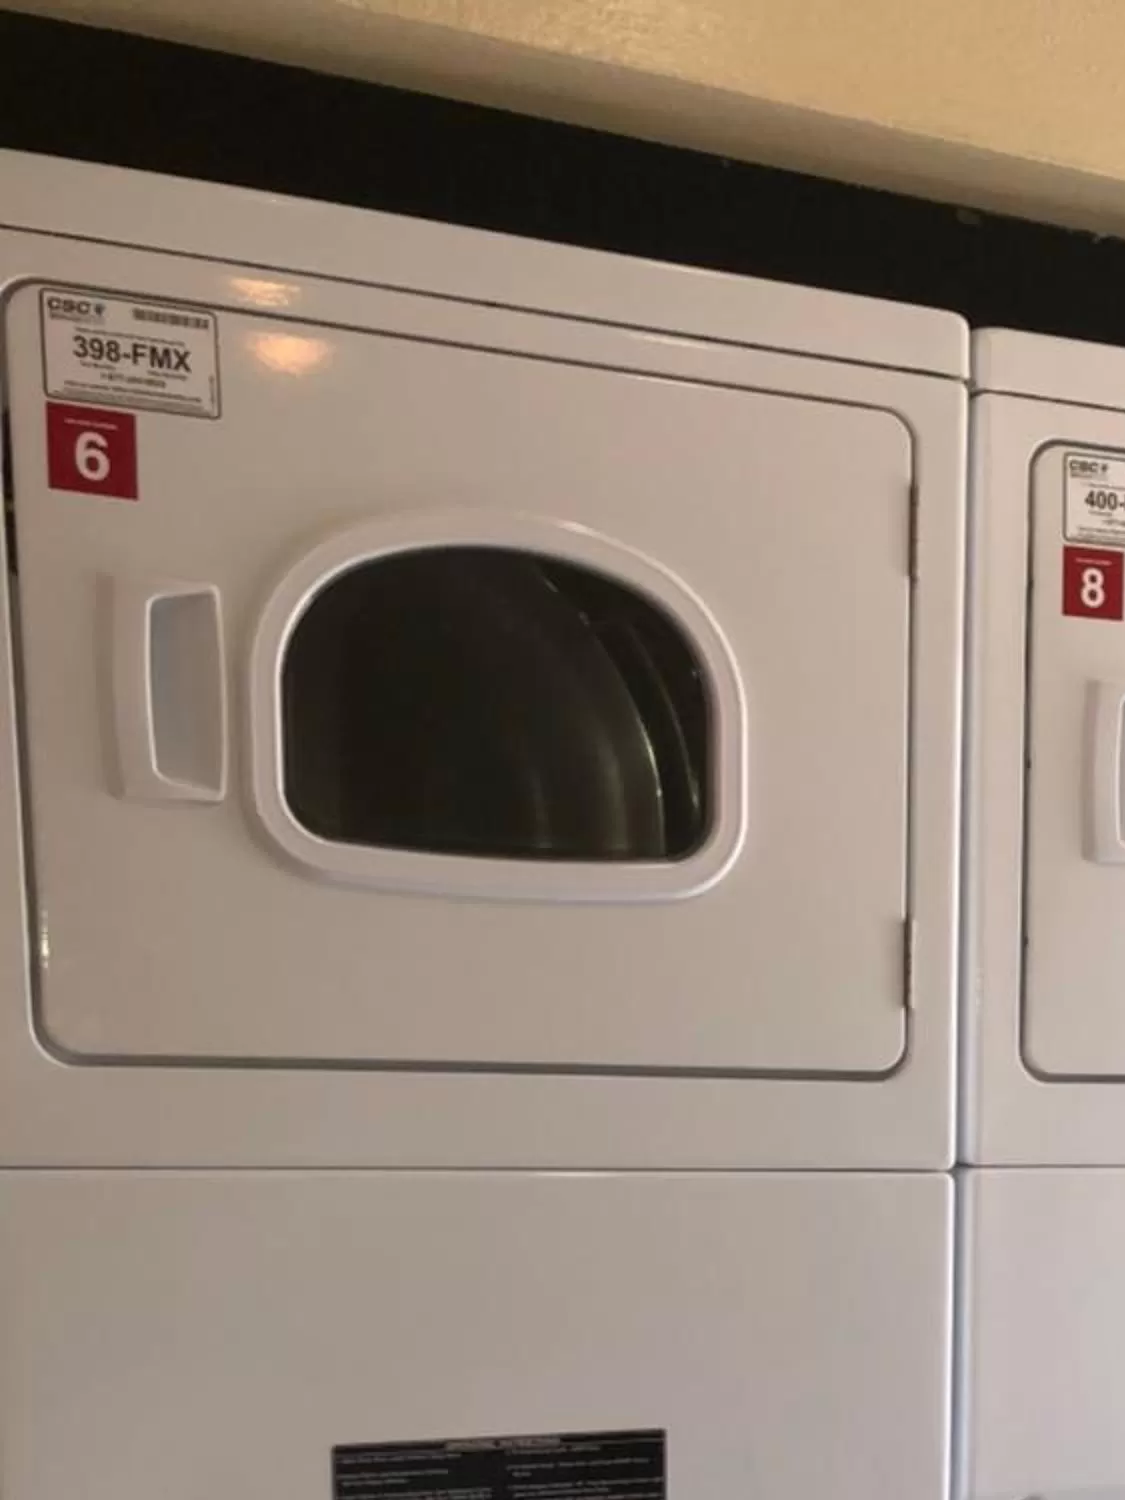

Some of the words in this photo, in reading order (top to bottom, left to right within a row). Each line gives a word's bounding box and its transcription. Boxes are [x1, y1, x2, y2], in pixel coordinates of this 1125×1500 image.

[72, 334, 192, 373] 398-FMX
[74, 431, 111, 481] 6
[1080, 567, 1105, 609] 8
